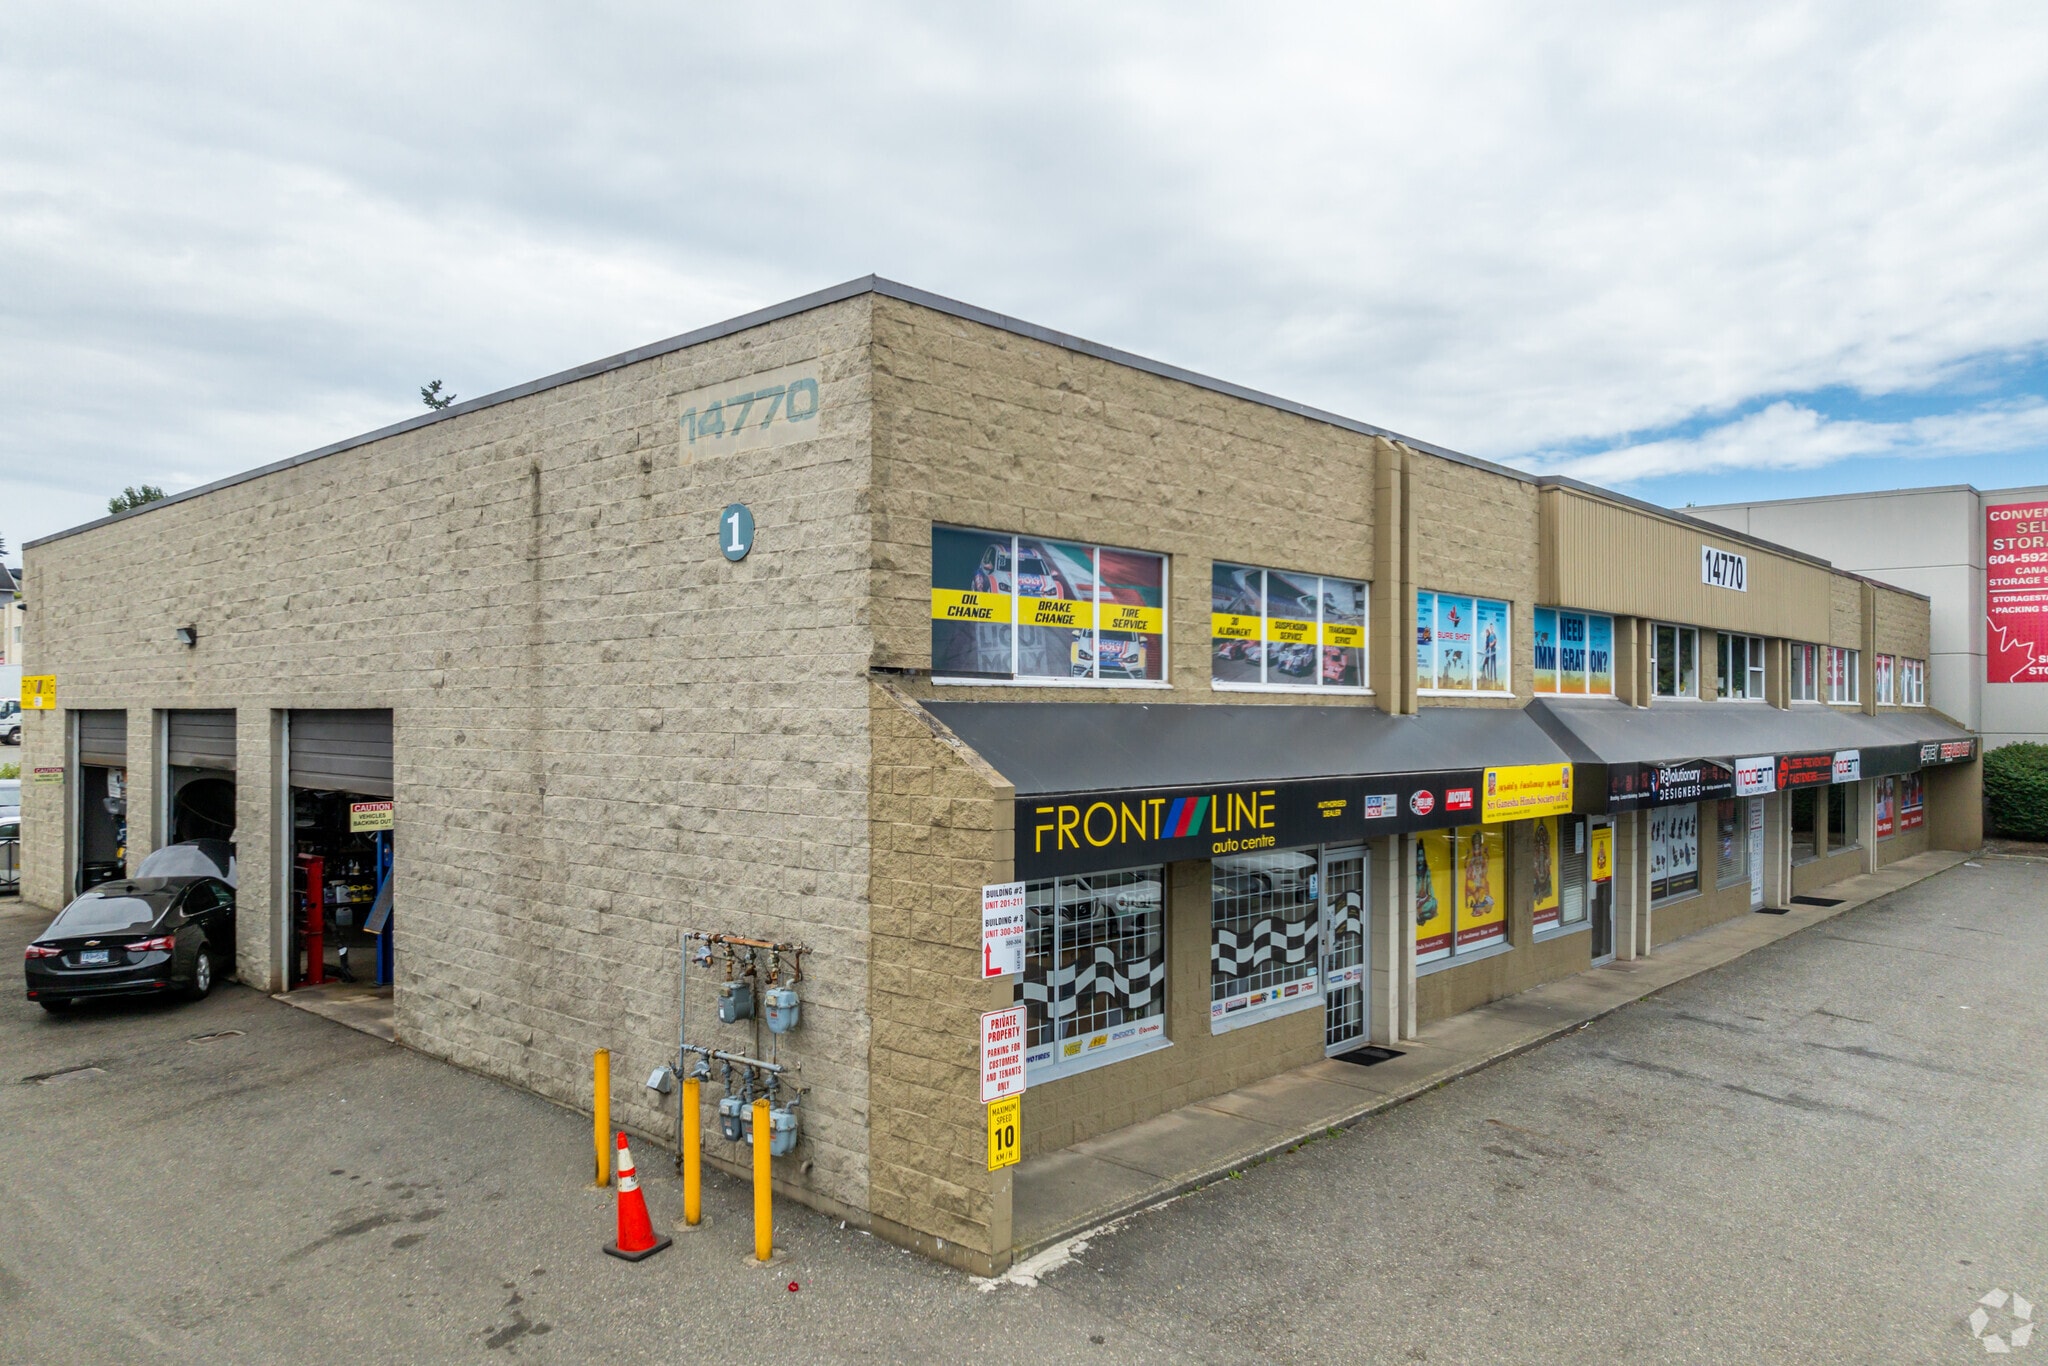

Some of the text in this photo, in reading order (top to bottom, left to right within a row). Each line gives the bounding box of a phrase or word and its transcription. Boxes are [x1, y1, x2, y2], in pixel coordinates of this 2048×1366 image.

[680, 377, 819, 445] 14770
[727, 512, 744, 552] 1
[1993, 537, 2048, 551] STOR
[1706, 550, 1743, 589] 14770
[1989, 576, 2041, 586] STORAGE
[961, 594, 979, 606] OIL
[1992, 595, 2048, 603] STORAGEST
[947, 606, 993, 619] CHANGE
[1038, 600, 1073, 613] BRAKE
[1121, 607, 1140, 618] TIRE
[1035, 614, 1075, 625] CHANGE
[1112, 618, 1149, 630] SERVICE
[1217, 626, 1252, 637] ALIGNMENT
[1274, 621, 1308, 632] SUSPENSION
[1560, 617, 1584, 642] NEED
[1279, 632, 1303, 642] SERVICE
[1334, 636, 1351, 645] SERVICE
[1437, 631, 1454, 639] SURE
[1660, 785, 1700, 801] DESIGNERS
[354, 803, 391, 812] CAUTION
[359, 812, 386, 820] VEHICLES
[1036, 790, 1275, 852] FRONT LINE
[1212, 834, 1275, 853] auto centre
[986, 886, 1023, 898] BUILDING #2
[985, 898, 1023, 910] UNIT 201-211
[985, 916, 1012, 927] BUILDING
[985, 926, 1024, 938] UNIT 300-304
[990, 1014, 1017, 1030] PRIVATE
[987, 1026, 1020, 1043] PROPERTY
[987, 1042, 1020, 1058] PARKING FOR
[989, 1054, 1019, 1070] CUSTOMERS
[1035, 1052, 1050, 1062] TIRES
[986, 1065, 1022, 1083] AND TENANTS
[997, 1081, 1010, 1091] ONLY
[992, 1103, 1017, 1116] MAXIMUM
[996, 1114, 1013, 1125] SPEED
[995, 1125, 1014, 1151] 10
